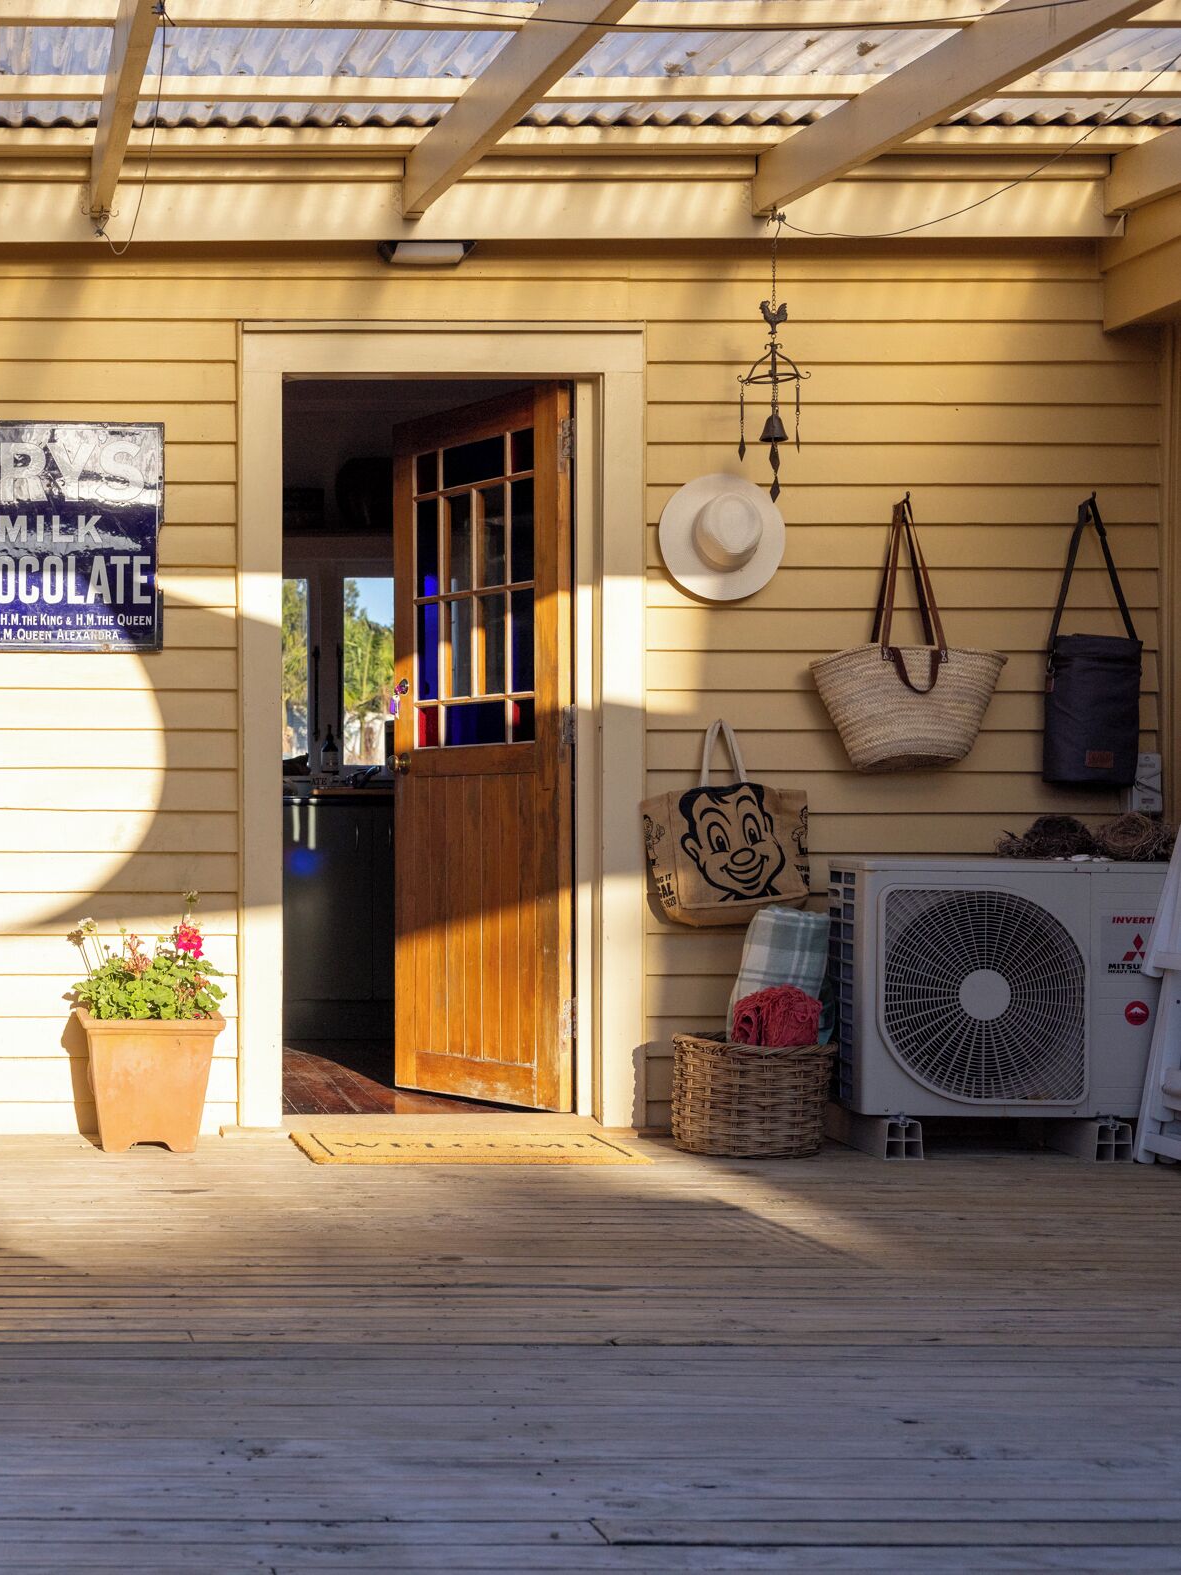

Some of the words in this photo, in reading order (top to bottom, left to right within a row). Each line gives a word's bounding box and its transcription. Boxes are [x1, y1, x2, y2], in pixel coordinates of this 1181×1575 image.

[0, 515, 103, 543] MILK
[40, 613, 63, 626] KING
[65, 615, 72, 625] &
[117, 613, 153, 627] QUEEN
